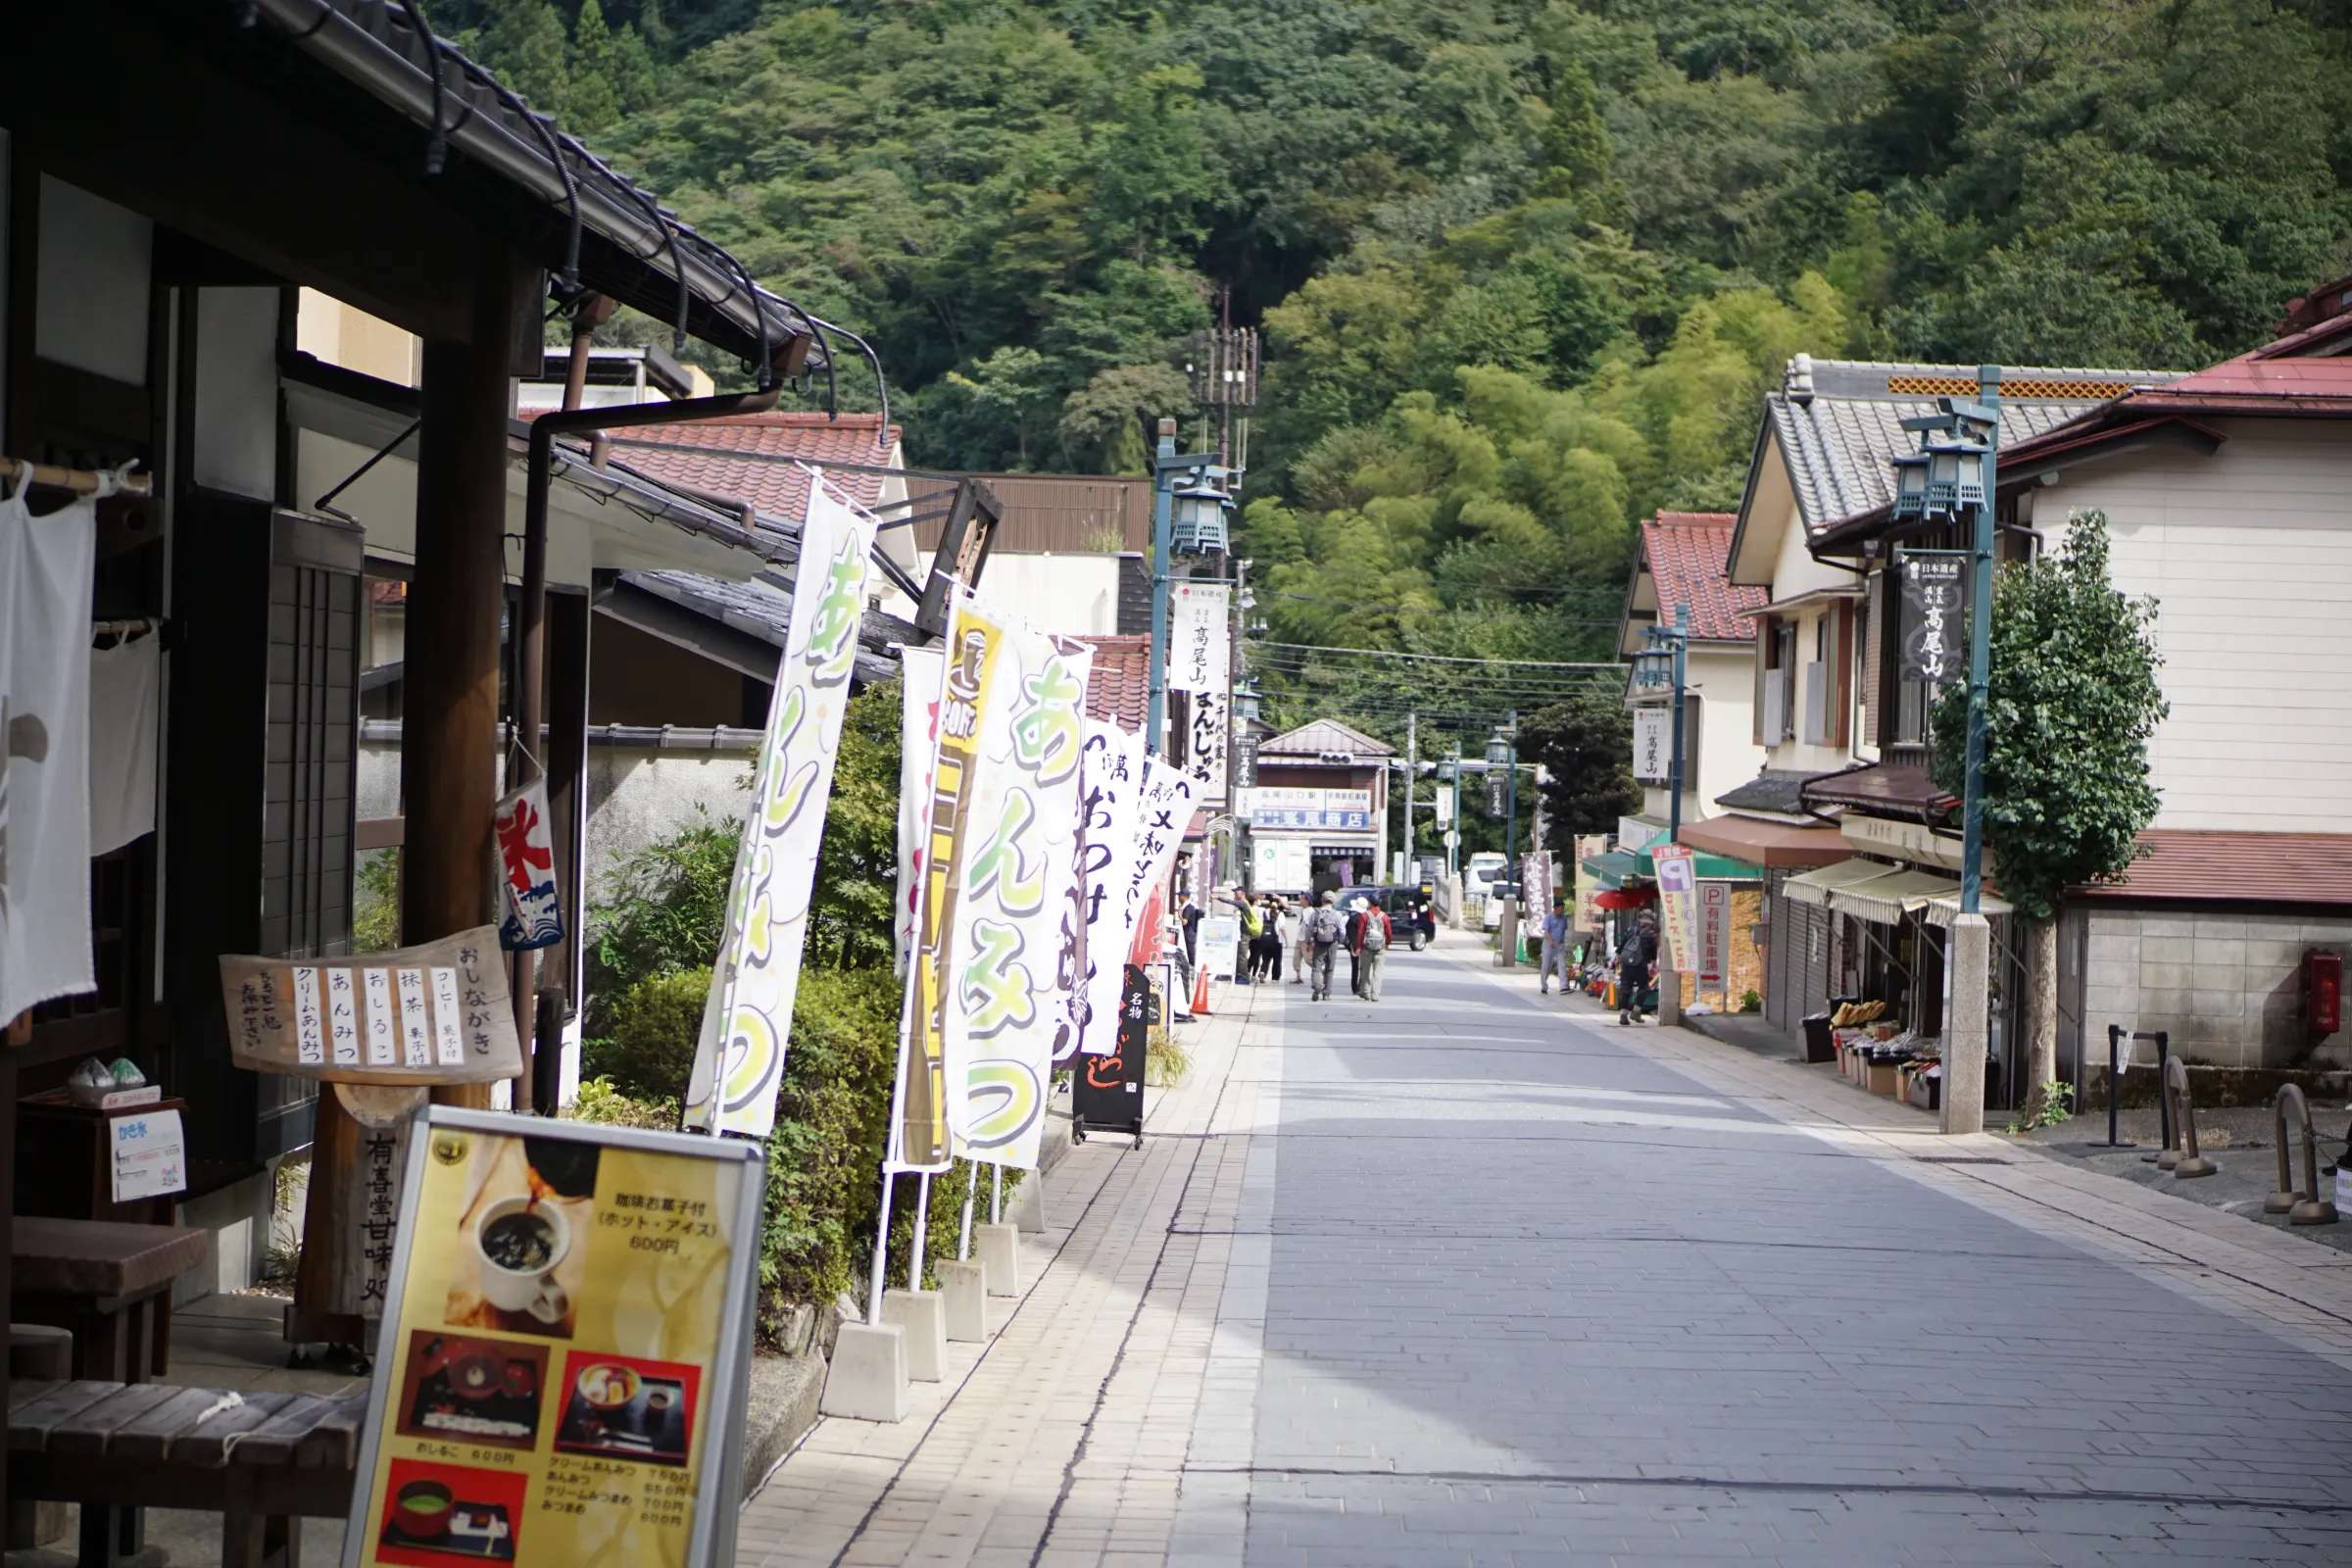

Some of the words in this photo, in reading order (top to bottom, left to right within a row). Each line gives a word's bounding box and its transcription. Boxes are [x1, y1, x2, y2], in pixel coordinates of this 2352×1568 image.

[1922, 564, 1958, 573] 日本遺産
[1189, 626, 1208, 685] 高尾山
[1922, 606, 1943, 677] 高尾山
[1645, 736, 1657, 774] 高尾山
[961, 654, 1083, 1146] あんみつ
[1705, 907, 1719, 972] 有料駐車場
[297, 968, 321, 1062] クリームあんみつ
[332, 973, 356, 1059] あんみつ
[368, 973, 388, 1059] おしるこ
[401, 972, 423, 1012] 抹茶
[437, 972, 453, 1011] コーヒー
[459, 947, 491, 1055] おしながき
[1128, 992, 1144, 1020] 名物
[614, 1193, 707, 1217] 珈琲お菓子付
[416, 1443, 460, 1458] おしるこ
